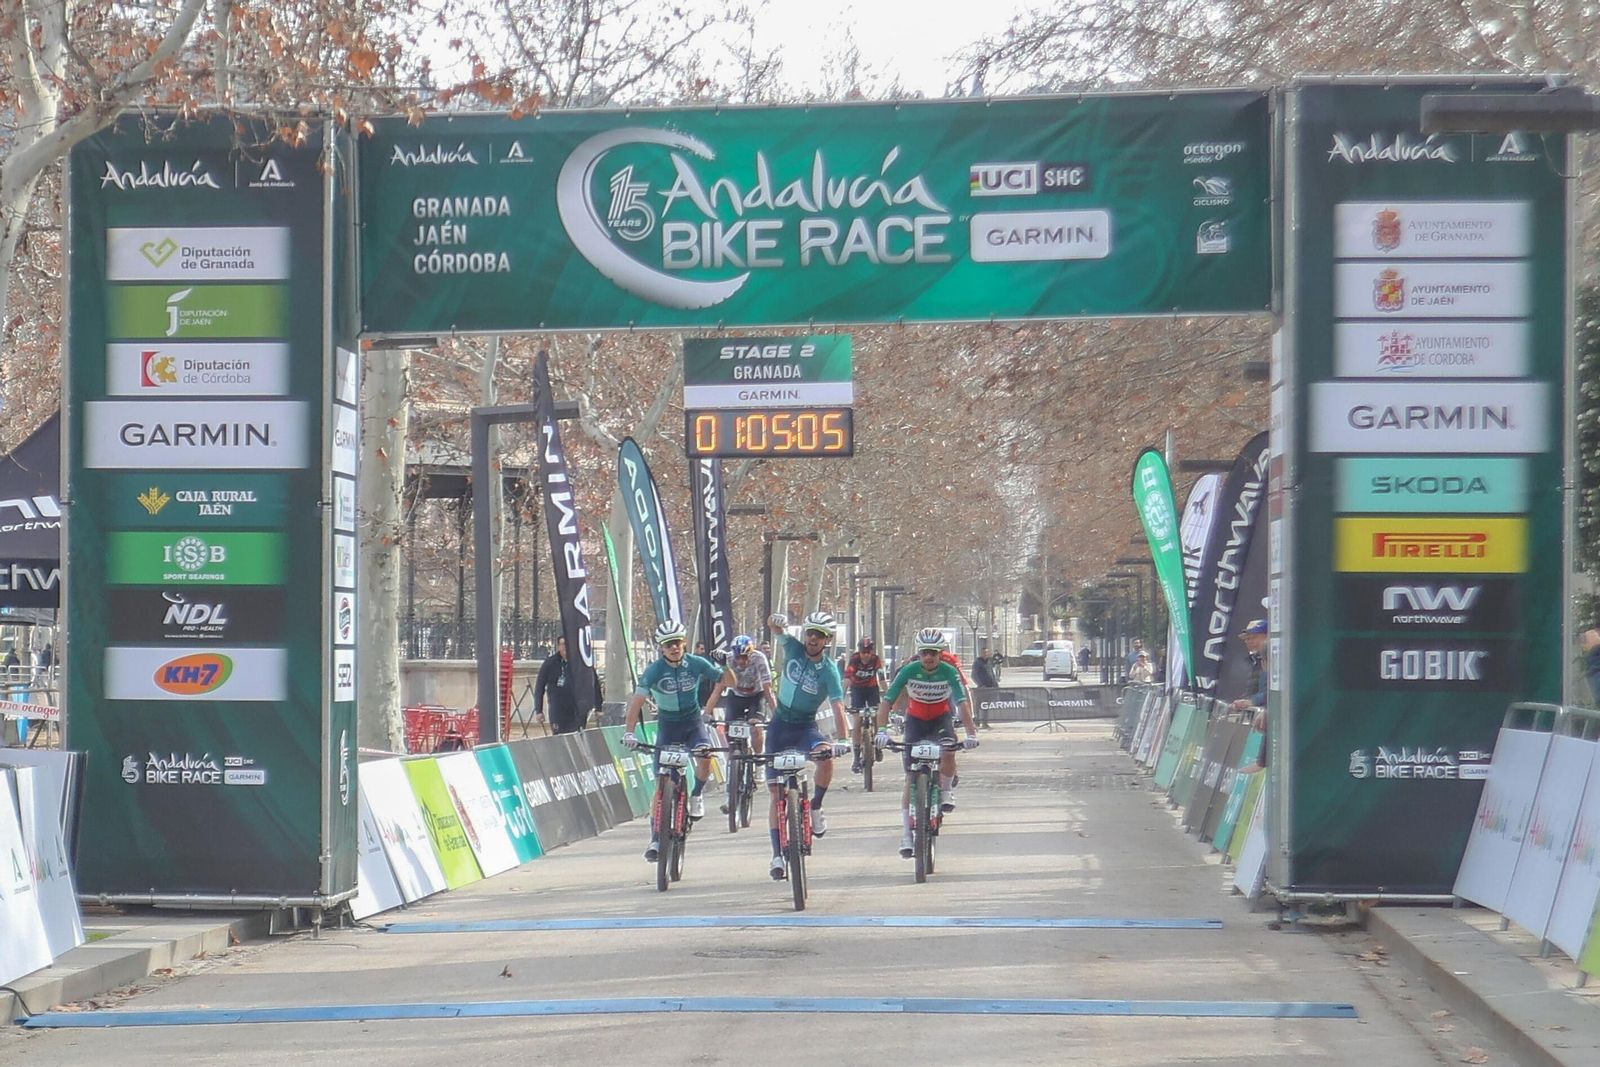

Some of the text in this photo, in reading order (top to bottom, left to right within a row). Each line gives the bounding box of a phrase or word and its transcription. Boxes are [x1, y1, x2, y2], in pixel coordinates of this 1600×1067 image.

[390, 141, 479, 166] Andalucía
[1183, 142, 1242, 161] octagon
[1327, 131, 1453, 164] Andalucía
[100, 159, 220, 190] Andalucía
[658, 145, 949, 219] Andalucía
[981, 169, 1081, 191] UCI SHC
[413, 195, 511, 219] GRANADA
[608, 219, 642, 228] YEARS
[413, 220, 467, 246] JAÉN
[663, 214, 953, 268] BIKE RACE
[986, 226, 1094, 246] GARMIN
[181, 245, 251, 261] Diputación
[181, 258, 255, 270] de Granada
[414, 249, 511, 274] CÓRDOBA
[1411, 285, 1491, 294] AYUNTAMIENTO
[1411, 296, 1454, 306] DE JAÉN
[1414, 336, 1490, 349] AYUNTAMIENTO
[719, 344, 816, 360] STAGE 2
[1414, 353, 1427, 365] DE
[183, 358, 251, 373] Diputación
[733, 364, 801, 380] GRANADA
[183, 372, 251, 384] de Córdoba
[738, 390, 799, 401] GARMIN
[1347, 405, 1509, 430] GARMIN
[119, 422, 271, 447] GARMIN
[175, 490, 257, 503] CAJA RURAL
[199, 502, 232, 516] JAÉN
[542, 425, 592, 668] GARMIN
[1372, 532, 1487, 558] PIRELLI
[163, 603, 227, 625] NDL
[1392, 615, 1462, 624] northwave
[1380, 650, 1477, 680] GOBIK
[980, 700, 1026, 710] GARMIN
[1048, 699, 1094, 707] GARMIN
[666, 752, 681, 764] 7-2
[918, 746, 932, 756] 3-1
[1375, 746, 1455, 765] Andalucía
[146, 752, 220, 771] Andalucía
[782, 756, 797, 766] 7-1
[146, 771, 221, 785] BIKE RACE
[1375, 765, 1456, 779] BIKE RACE
